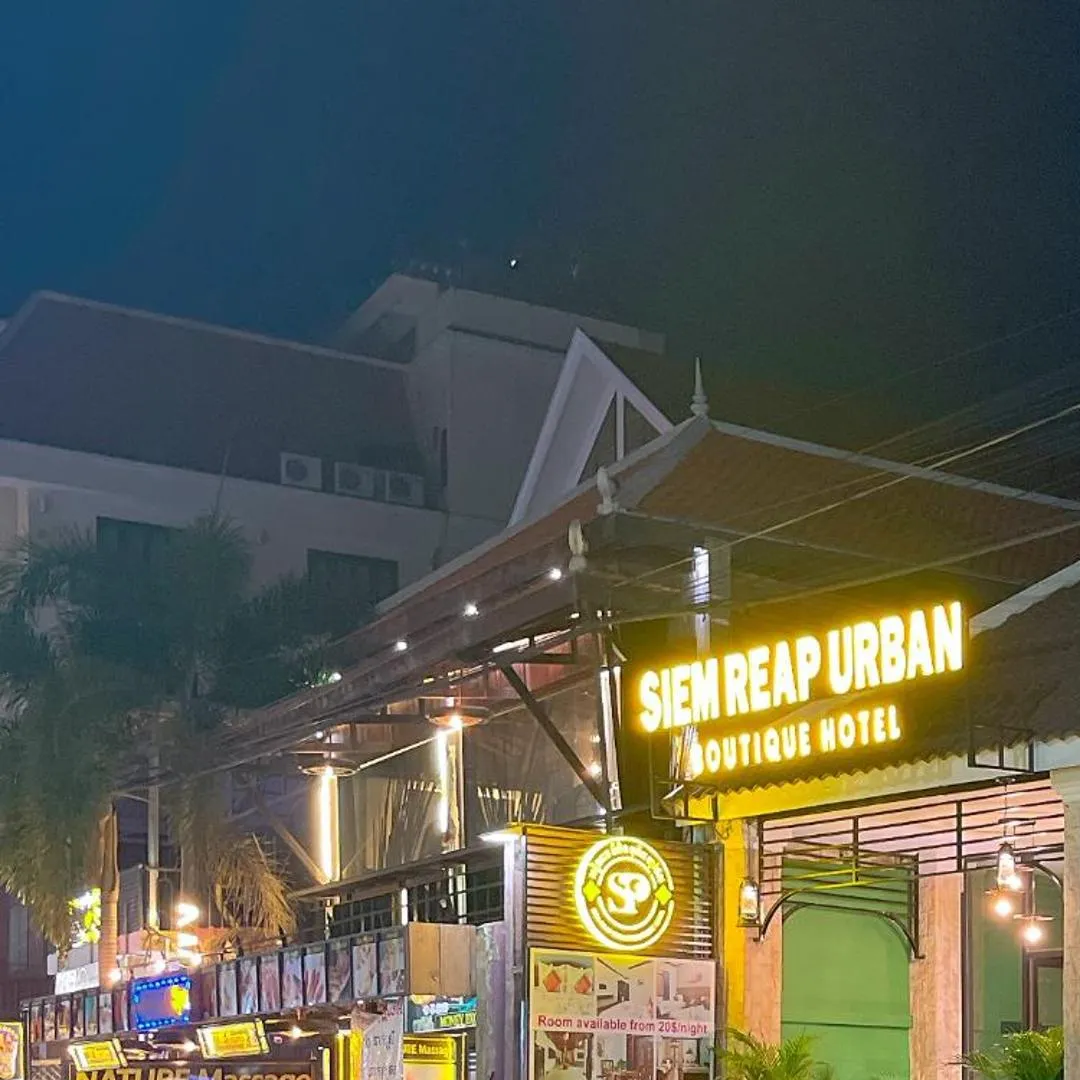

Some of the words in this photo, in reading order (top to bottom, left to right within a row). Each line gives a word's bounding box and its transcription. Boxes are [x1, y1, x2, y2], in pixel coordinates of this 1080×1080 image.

[639, 656, 720, 733] SIEM
[723, 635, 821, 717] REAP
[827, 600, 963, 694] URBAN
[820, 704, 901, 752] HOTEL
[538, 1015, 572, 1028] Room
[577, 1017, 627, 1031] available
[630, 1018, 656, 1032] from
[658, 1020, 708, 1036] 20$/night
